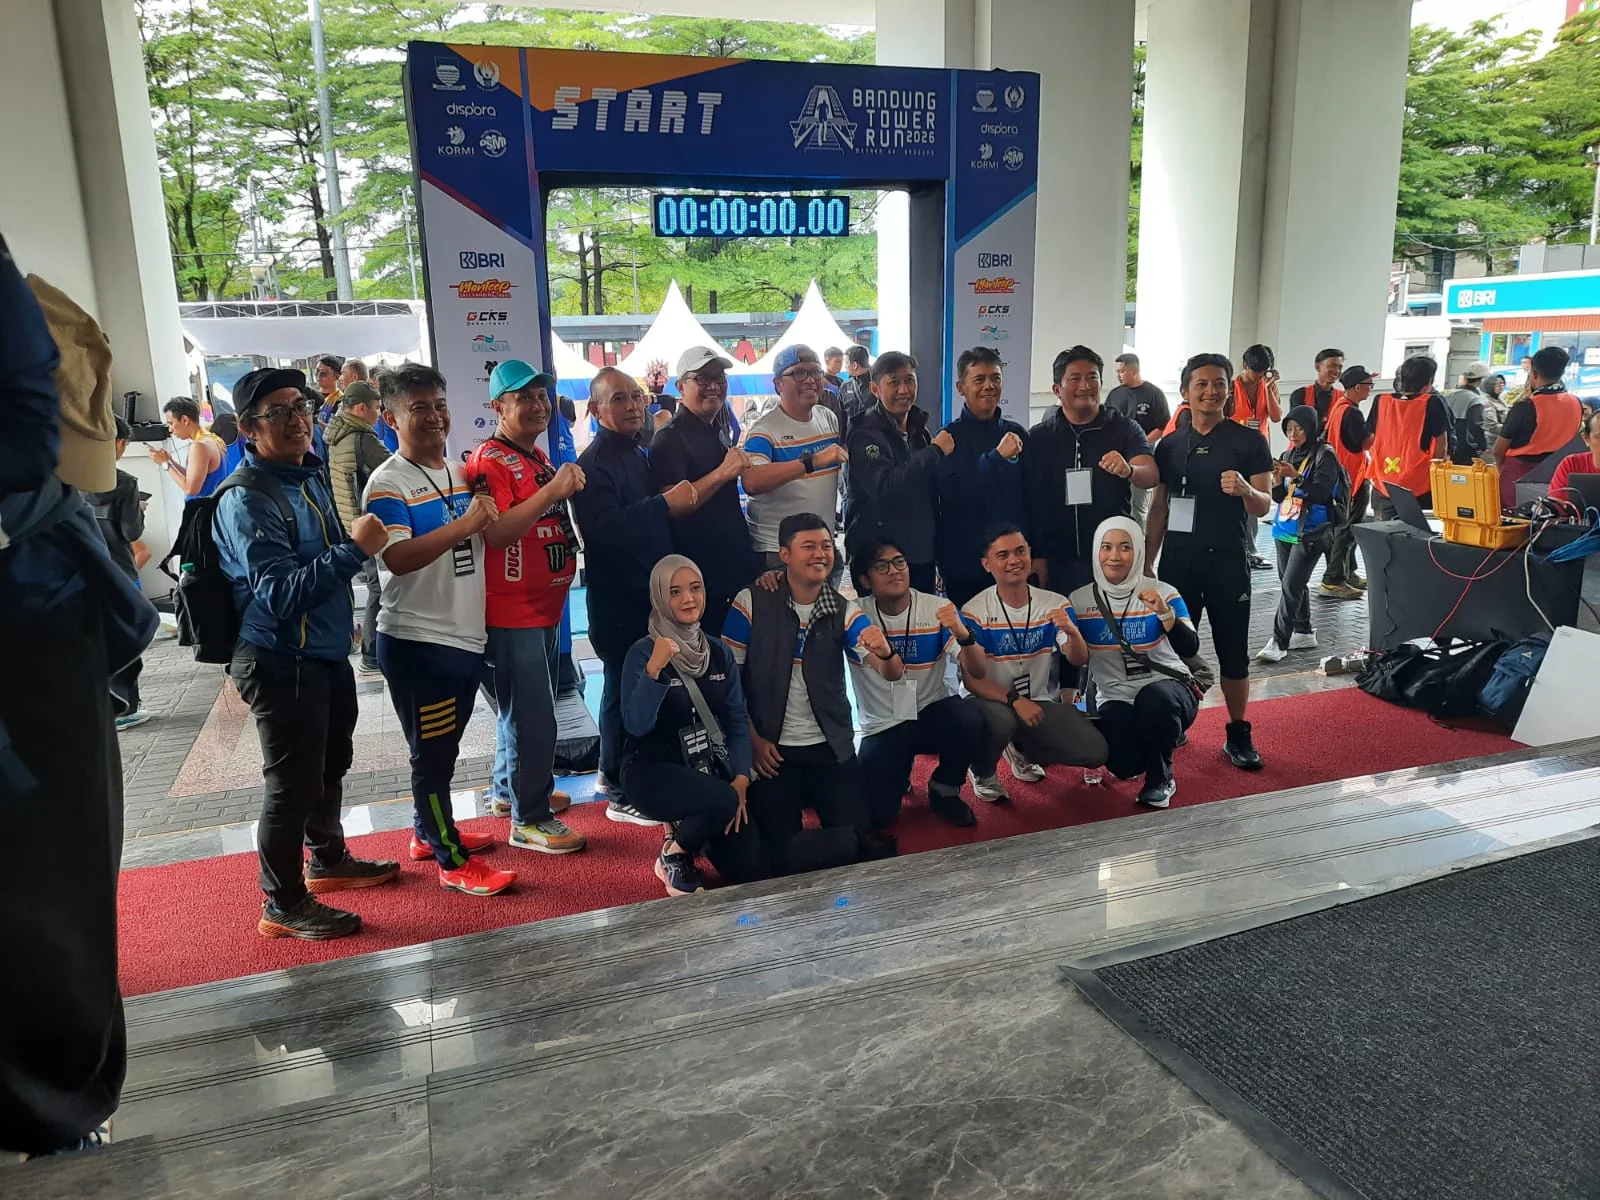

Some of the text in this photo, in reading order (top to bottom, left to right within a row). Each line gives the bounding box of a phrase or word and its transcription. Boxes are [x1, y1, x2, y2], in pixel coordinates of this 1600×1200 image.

[852, 88, 936, 110] BANDUNG
[551, 86, 723, 135] START
[866, 109, 935, 130] TOWER
[865, 128, 936, 148] RUN 2026
[438, 146, 475, 155] KORMI
[970, 160, 999, 169] KORMI
[658, 197, 845, 234] 00:00:00.00
[478, 253, 505, 268] BRI
[991, 254, 1012, 268] BRI
[1473, 289, 1496, 306] BRI
